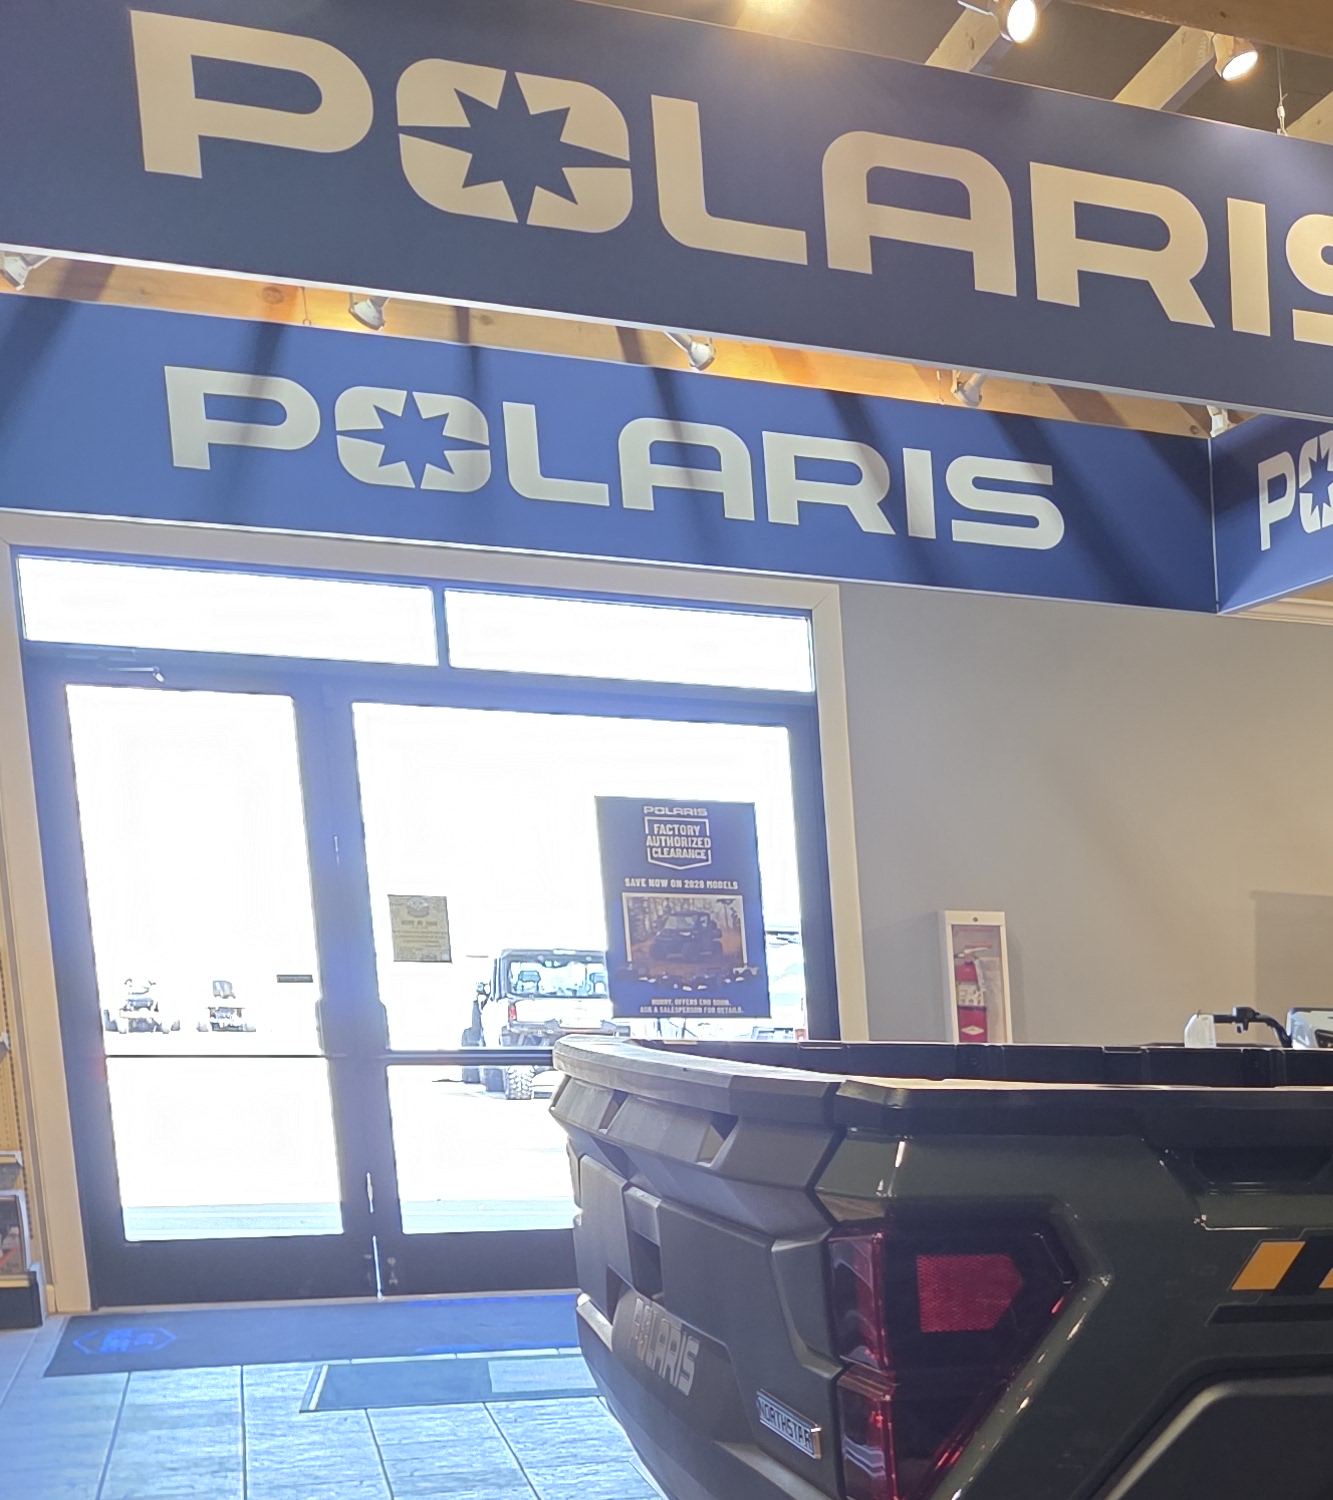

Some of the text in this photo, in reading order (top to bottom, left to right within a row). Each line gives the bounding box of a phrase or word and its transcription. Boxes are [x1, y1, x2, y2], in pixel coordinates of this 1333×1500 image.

[163, 365, 1065, 552] POLARIS
[643, 806, 708, 816] POLARIS
[653, 823, 700, 836] FACTORY
[646, 835, 711, 848] AUTHORIZED
[652, 847, 706, 859] CLEARANCE
[624, 877, 647, 888] SAVE
[648, 878, 668, 888] NOW
[670, 879, 682, 889] ON
[706, 880, 738, 890] MODELS
[628, 1298, 700, 1397] POLARIS
[758, 1398, 813, 1451] NORTHSTAR
